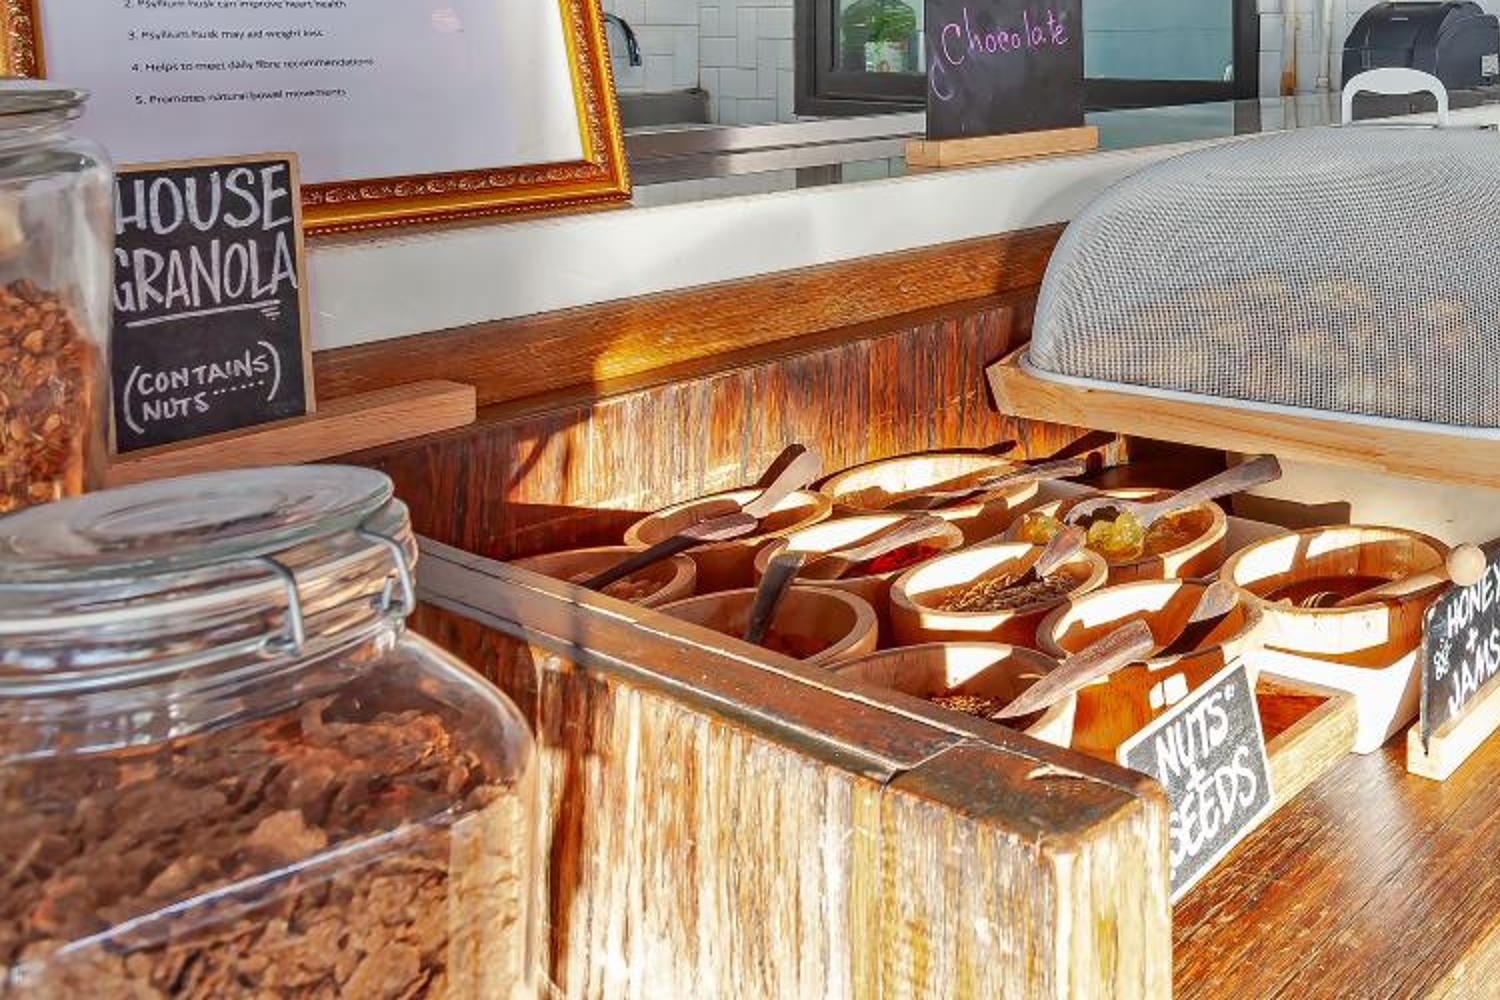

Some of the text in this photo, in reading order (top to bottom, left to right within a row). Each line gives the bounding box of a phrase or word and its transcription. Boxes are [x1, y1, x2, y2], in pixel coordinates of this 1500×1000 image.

[149, 93, 206, 104] Promotes
[114, 163, 292, 235] HOUSE
[113, 231, 298, 312] GRANOLA
